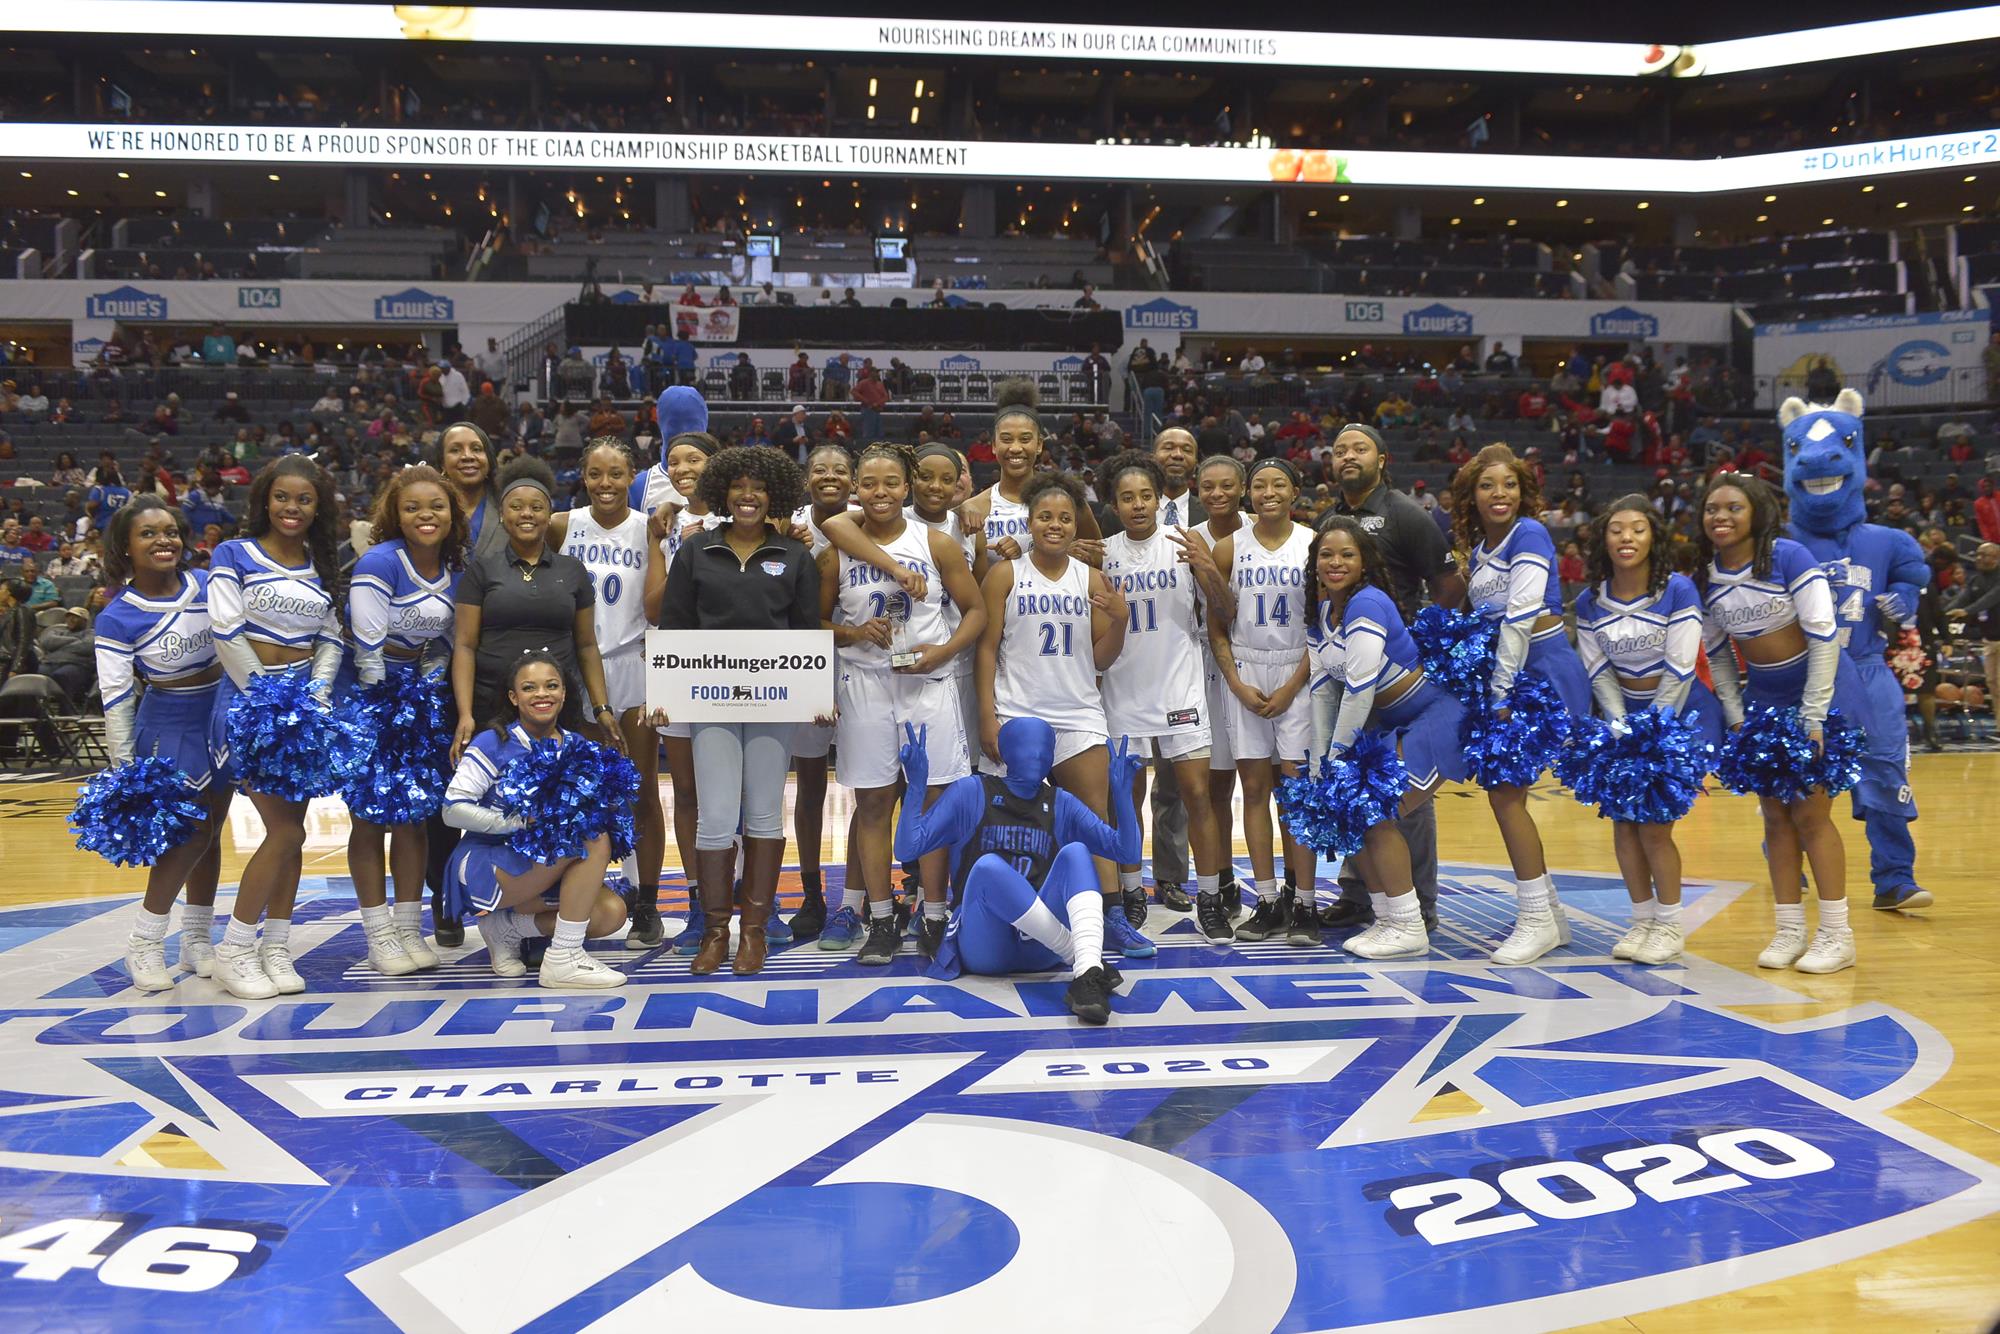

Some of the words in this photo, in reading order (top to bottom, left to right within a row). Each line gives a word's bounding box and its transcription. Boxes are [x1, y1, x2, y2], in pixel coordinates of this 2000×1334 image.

[878, 26, 983, 47] NOURISHING
[988, 31, 1056, 49] DREAMS
[1061, 32, 1077, 49] IN
[1083, 32, 1116, 51] OUR
[1121, 33, 1157, 52] CIAA
[1162, 35, 1277, 55] COMMUNITIES
[88, 130, 144, 150] WE'RE
[151, 132, 239, 152] HONORED
[245, 133, 268, 152] TO
[275, 134, 296, 153] BE
[302, 135, 312, 153] A
[319, 135, 380, 154] PROUD
[386, 136, 472, 155] SPONSOR
[479, 137, 499, 156] OF
[506, 138, 538, 157] THE
[545, 138, 585, 158] CIAA
[591, 139, 728, 161] CHAMPIONSHIP
[734, 142, 844, 163] BASKETBALL
[849, 145, 968, 166] TOURNAMENT
[92, 297, 161, 317] LOWE'S
[241, 289, 279, 307] 104
[380, 298, 448, 318] LOWE'S
[1132, 309, 1192, 328] LOWE'S
[1347, 304, 1382, 320] 106
[1408, 311, 1468, 333] LOWE'S
[1595, 315, 1654, 336] LOWE'S
[986, 518, 1029, 539] BRON
[848, 560, 930, 588] BROOS
[1110, 567, 1177, 594] RONCOS
[1238, 565, 1306, 588] BRONCO
[1017, 593, 1089, 618] BRONCO
[1126, 597, 1159, 634] 11
[1253, 592, 1291, 627] 14
[159, 625, 214, 662] Bron
[1038, 621, 1074, 656] 21
[652, 654, 827, 673] #DunkHunger2020
[691, 685, 730, 700] FOOD
[754, 686, 788, 700] LION
[344, 1070, 900, 1102] CHARLOTTE
[1046, 1057, 1270, 1077] 2020
[1389, 1127, 1835, 1246] 2020
[0, 1218, 258, 1292] 46
